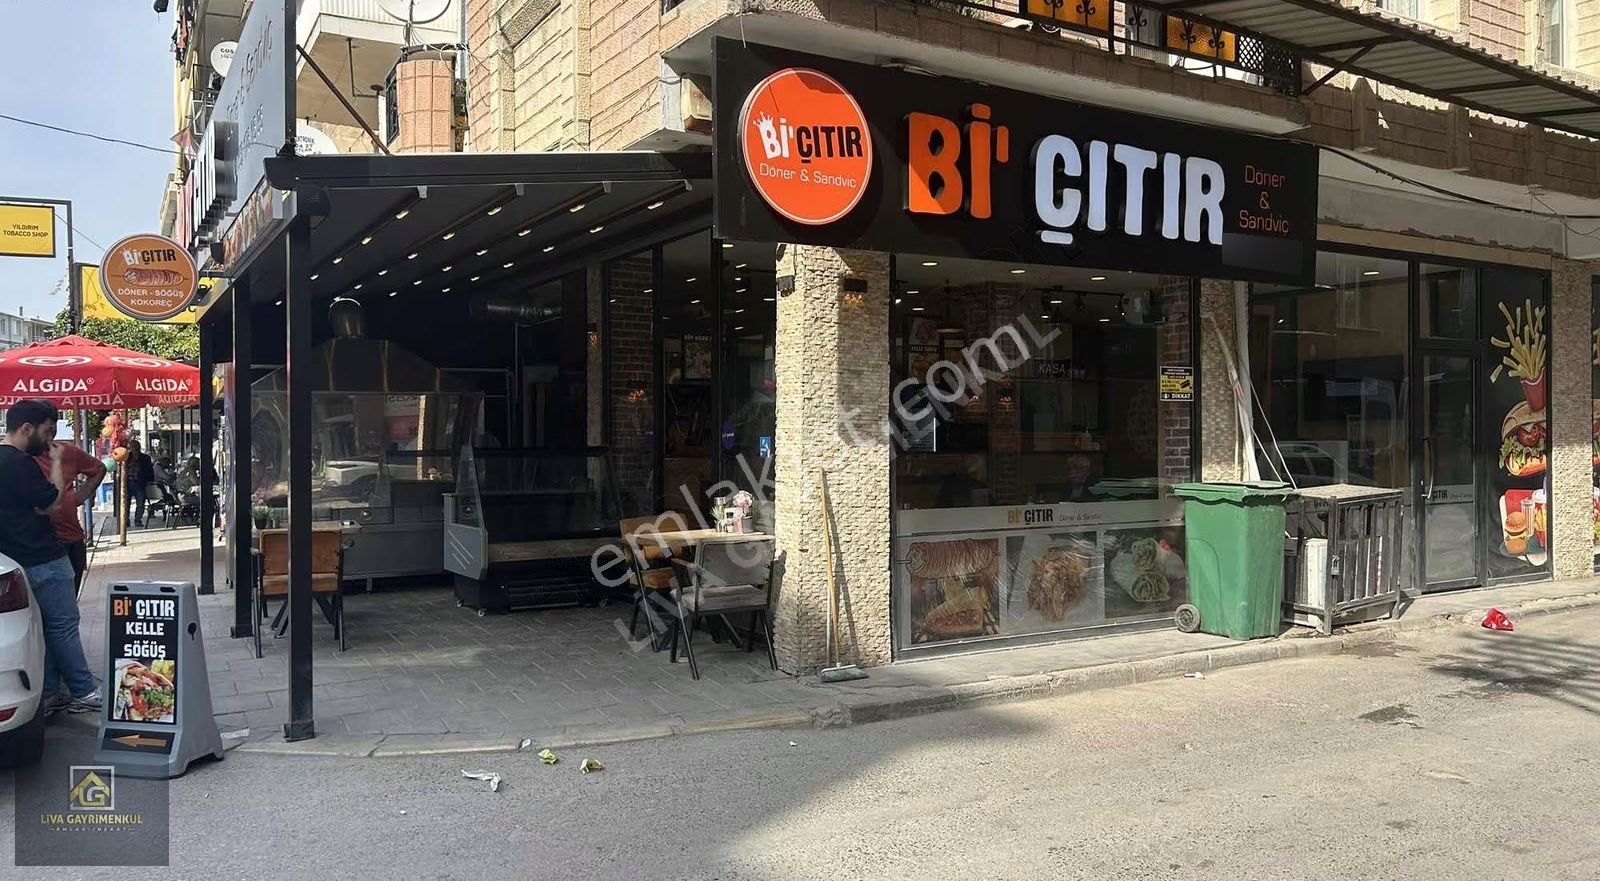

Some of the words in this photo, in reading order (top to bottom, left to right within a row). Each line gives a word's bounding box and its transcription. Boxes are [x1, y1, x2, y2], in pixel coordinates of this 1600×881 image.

[800, 169, 810, 182] &
[1035, 134, 1226, 246] ÇITIR
[1259, 191, 1271, 209] &
[130, 299, 173, 307] KOKOREÇ
[1038, 363, 1066, 375] KASA
[1024, 508, 1054, 525] ÇITIR
[135, 599, 175, 620] ÇITIR
[125, 621, 165, 636] KELLE
[123, 639, 166, 661] SÖĞÜŞ
